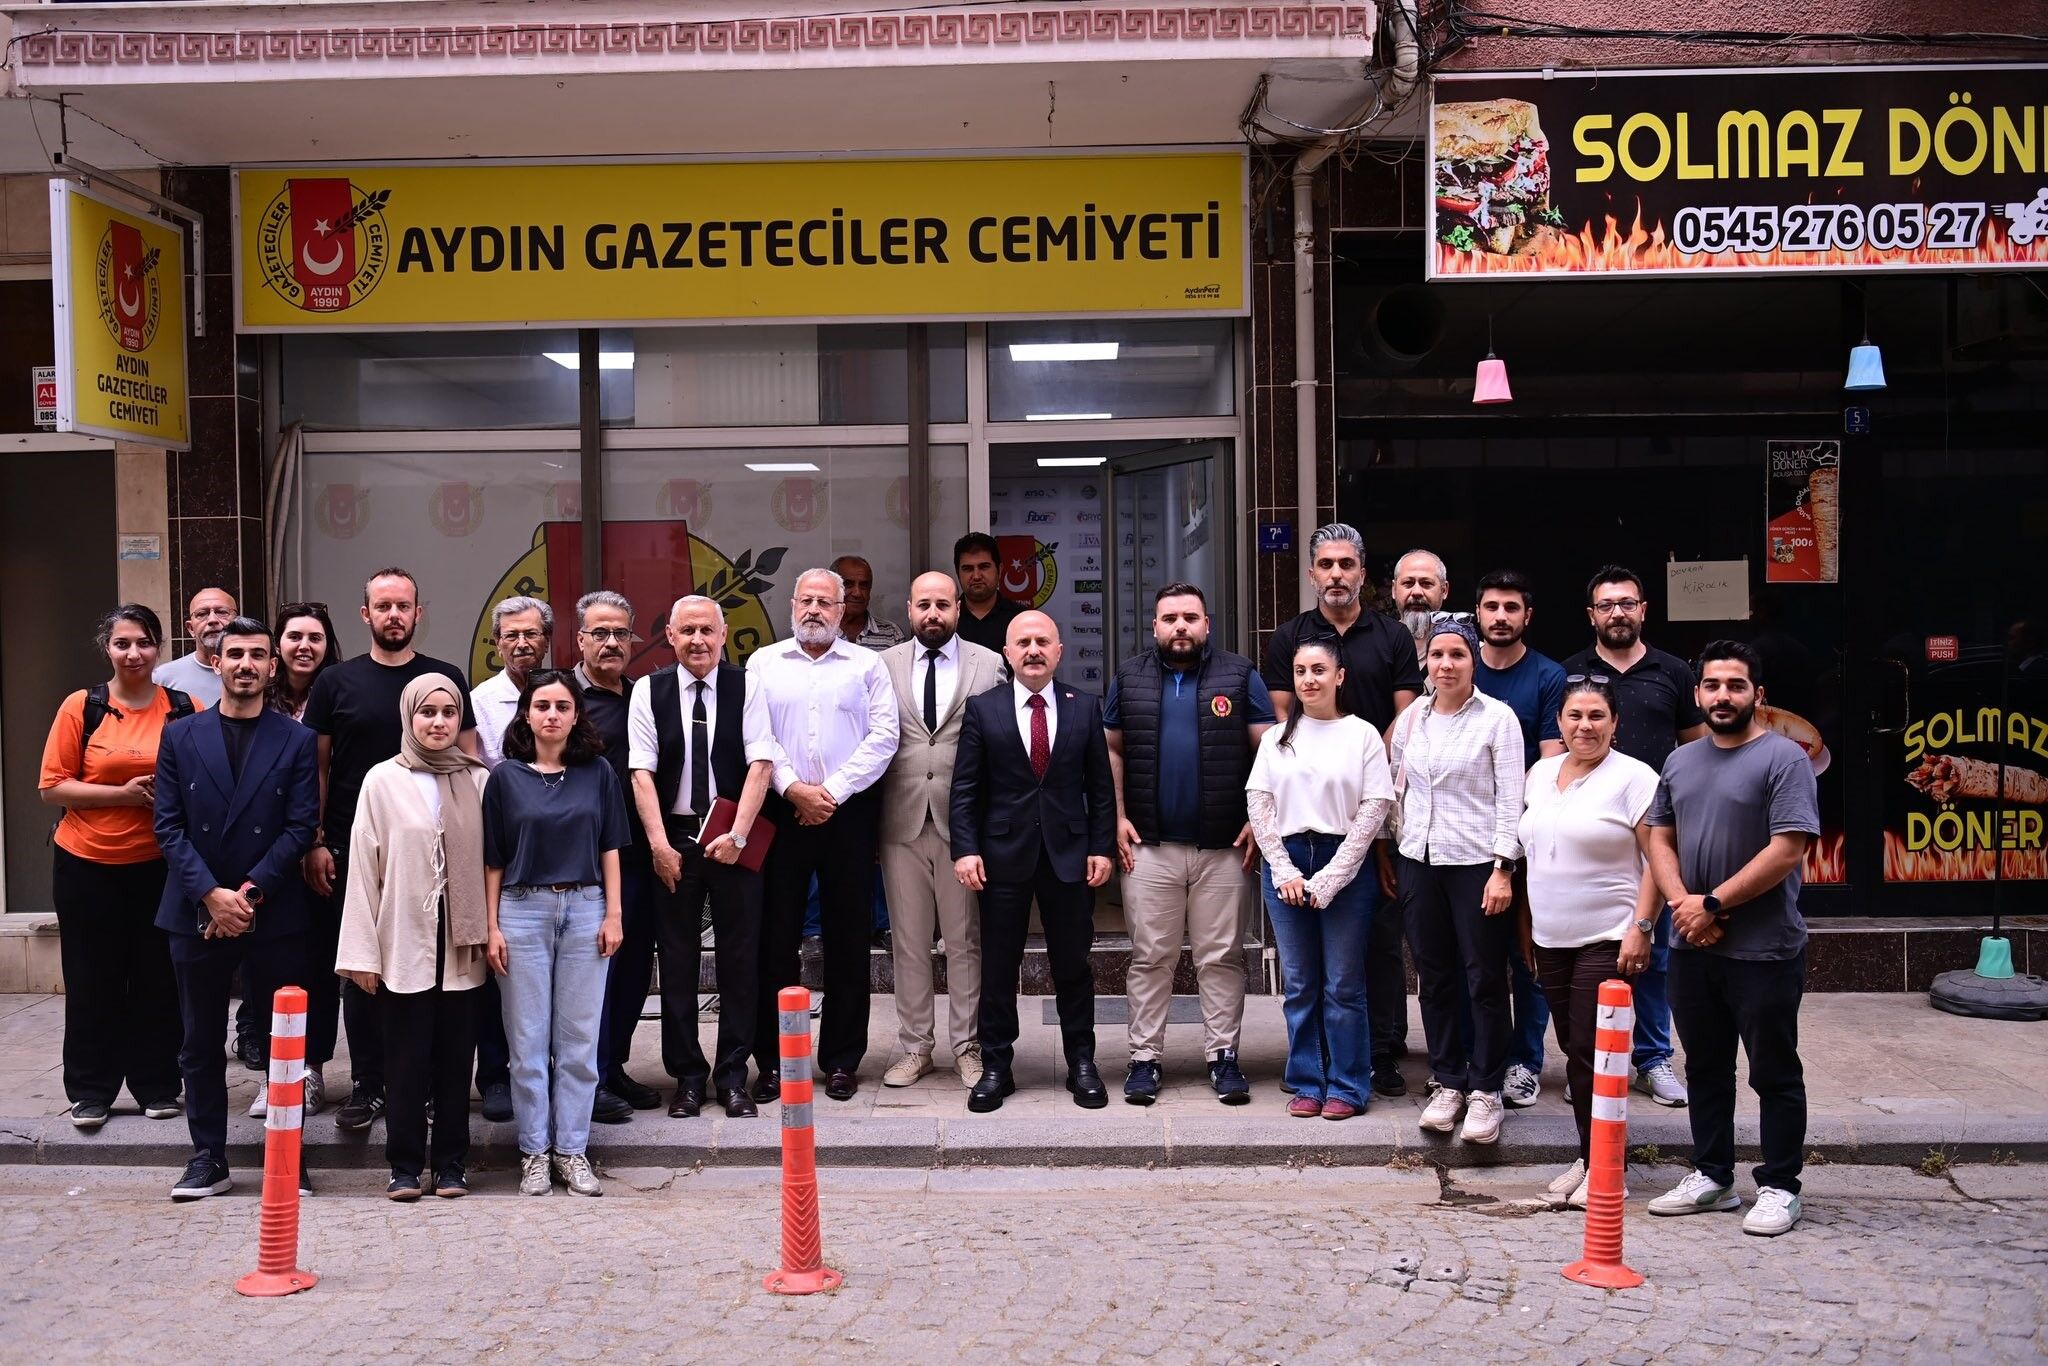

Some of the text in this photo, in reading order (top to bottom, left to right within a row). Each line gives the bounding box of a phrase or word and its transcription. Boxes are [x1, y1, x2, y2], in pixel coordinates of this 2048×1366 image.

[1572, 91, 2048, 183] SOLMAZ DÖN
[397, 200, 1220, 274] AYDIN GAZETECİLER CEMİYETİ
[1679, 206, 1981, 248] 0545 276 05 27
[263, 201, 300, 298] GAZETECİLER
[353, 223, 384, 296] CEMİYETİ
[99, 239, 119, 334] GAZETECİLER
[310, 287, 343, 297] AYDIN
[313, 297, 341, 308] 1990
[123, 326, 141, 340] AYDIN
[125, 337, 139, 349] 1990
[116, 353, 150, 378] AYDIN
[97, 373, 168, 405] GAZETECİLER
[109, 400, 159, 427] CEMİYETİ
[1853, 411, 1861, 424] 5
[1772, 449, 1812, 461] SOLMAZ
[1930, 638, 1954, 647] İTİNİZ
[1931, 650, 1954, 659] PUSH
[1903, 707, 2048, 763] SOLMAZ
[1907, 802, 2044, 850] DÖNER
